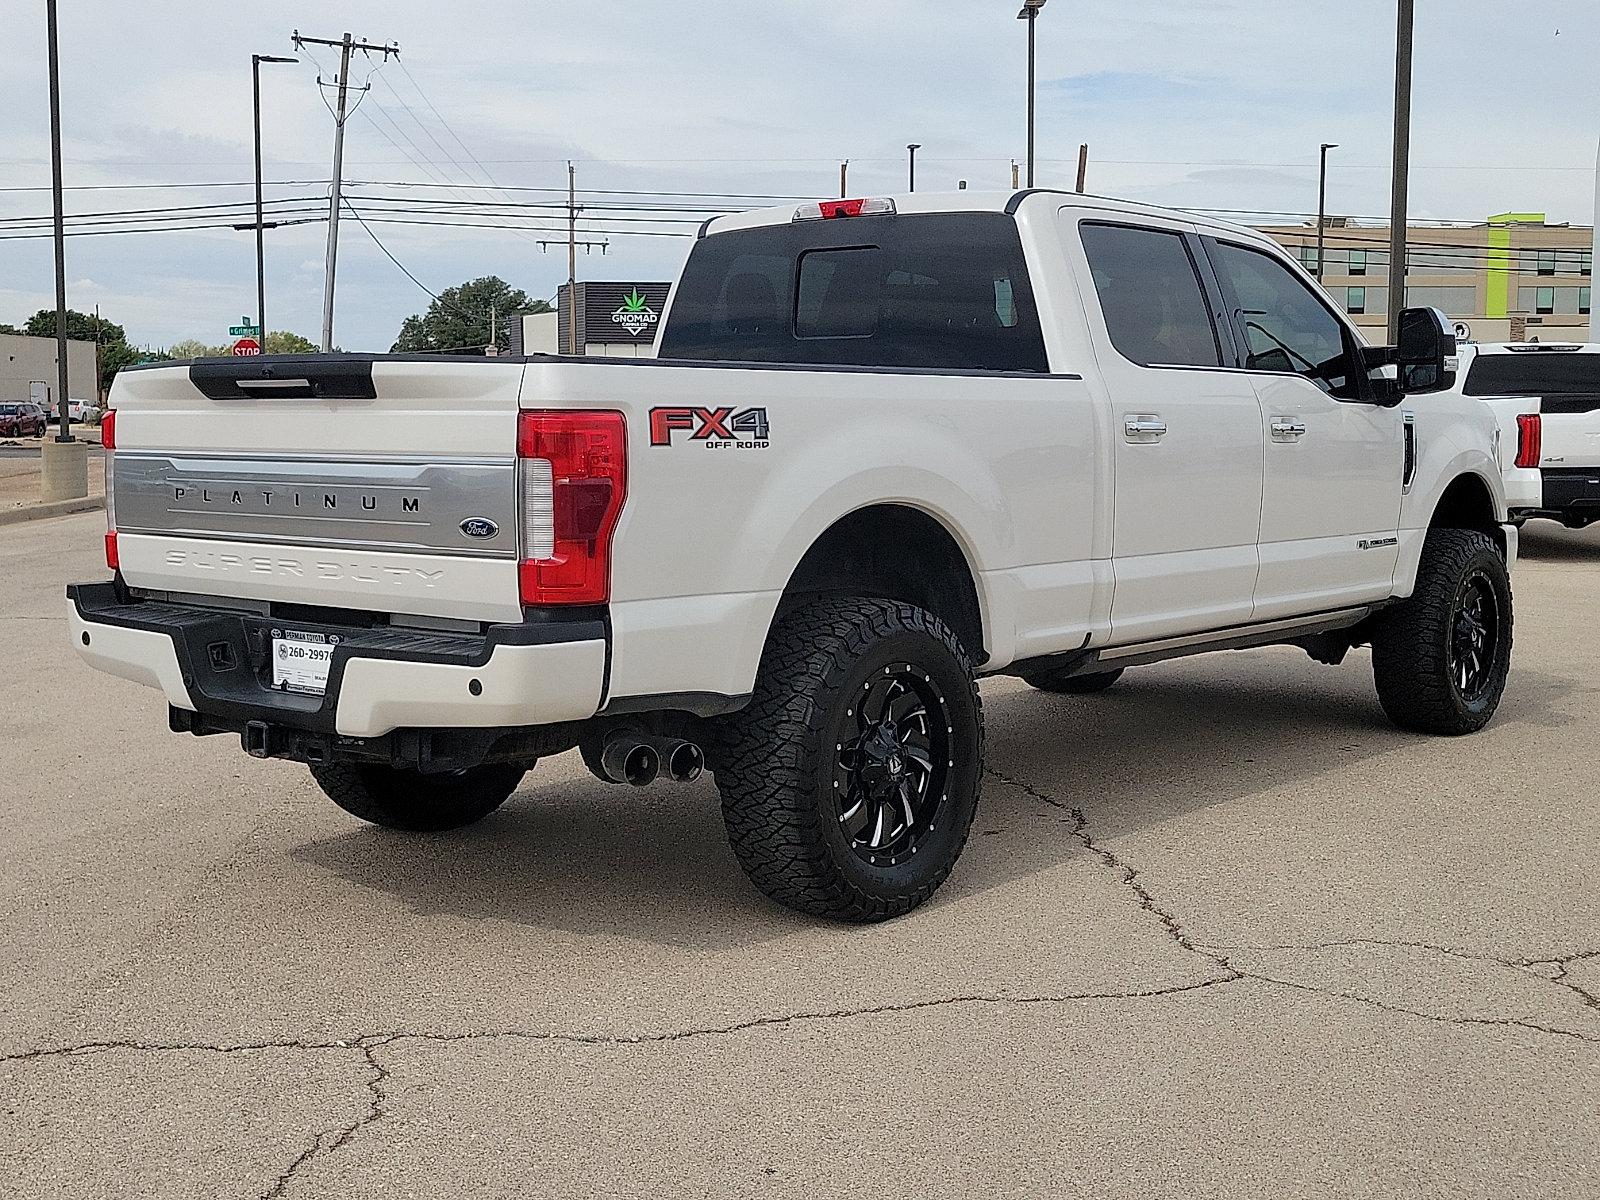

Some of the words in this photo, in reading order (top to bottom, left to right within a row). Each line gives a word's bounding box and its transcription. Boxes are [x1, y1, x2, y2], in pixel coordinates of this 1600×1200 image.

[612, 314, 658, 323] GNOMAD
[234, 347, 260, 356] STOP
[648, 406, 770, 447] FX4
[705, 441, 732, 449] OFF
[736, 441, 770, 449] ROAD
[174, 487, 420, 513] PLATINUM
[466, 521, 489, 535] Ford
[165, 550, 304, 577] SUPER
[316, 561, 444, 588] DUTY
